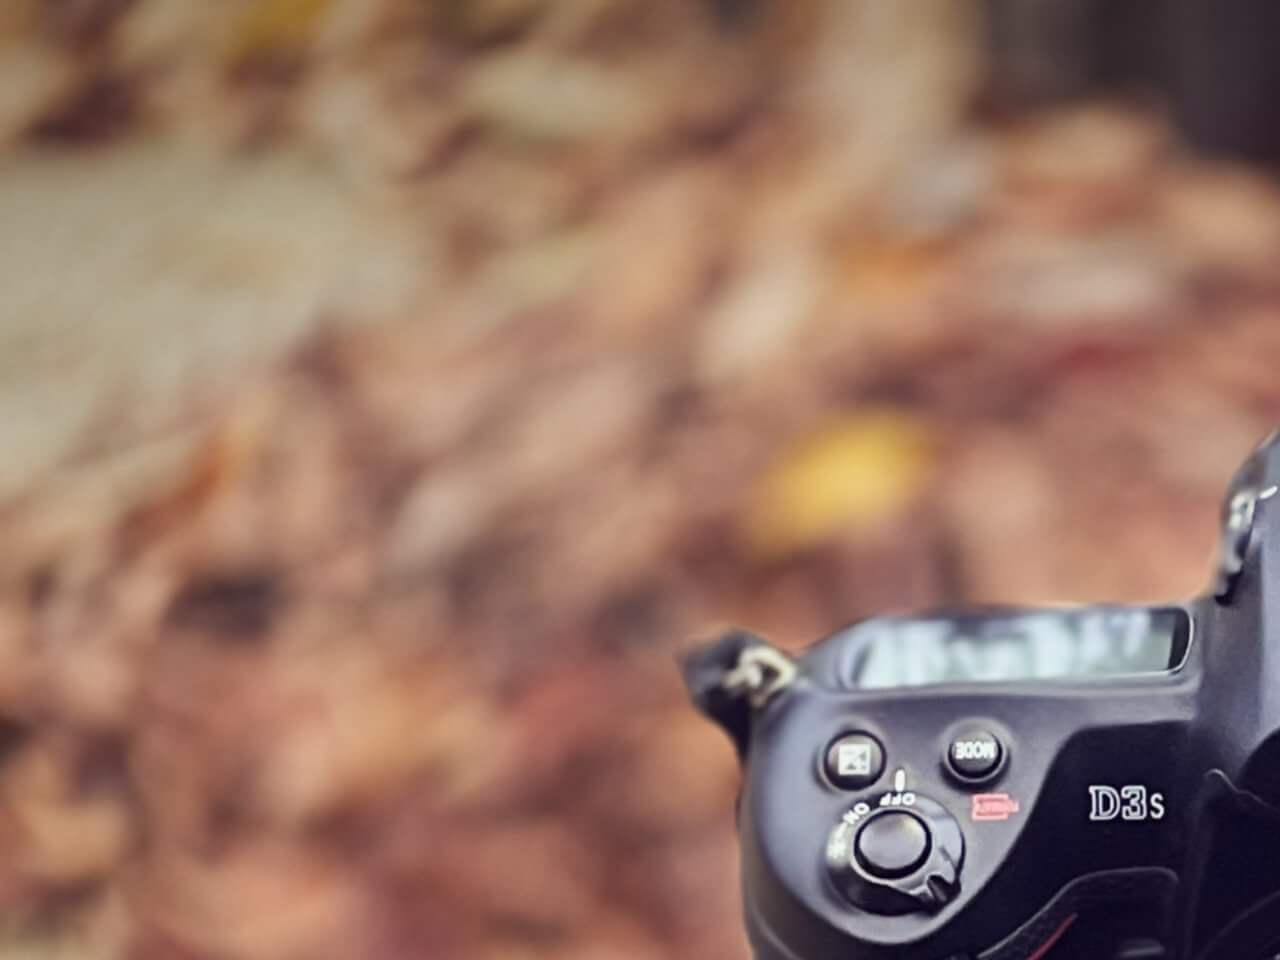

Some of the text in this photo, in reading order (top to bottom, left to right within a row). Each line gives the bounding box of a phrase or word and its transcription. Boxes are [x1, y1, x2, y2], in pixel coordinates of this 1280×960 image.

[954, 739, 996, 760] MODE
[879, 792, 916, 807] OFF
[1089, 784, 1164, 822] D3s
[843, 801, 870, 825] ON
